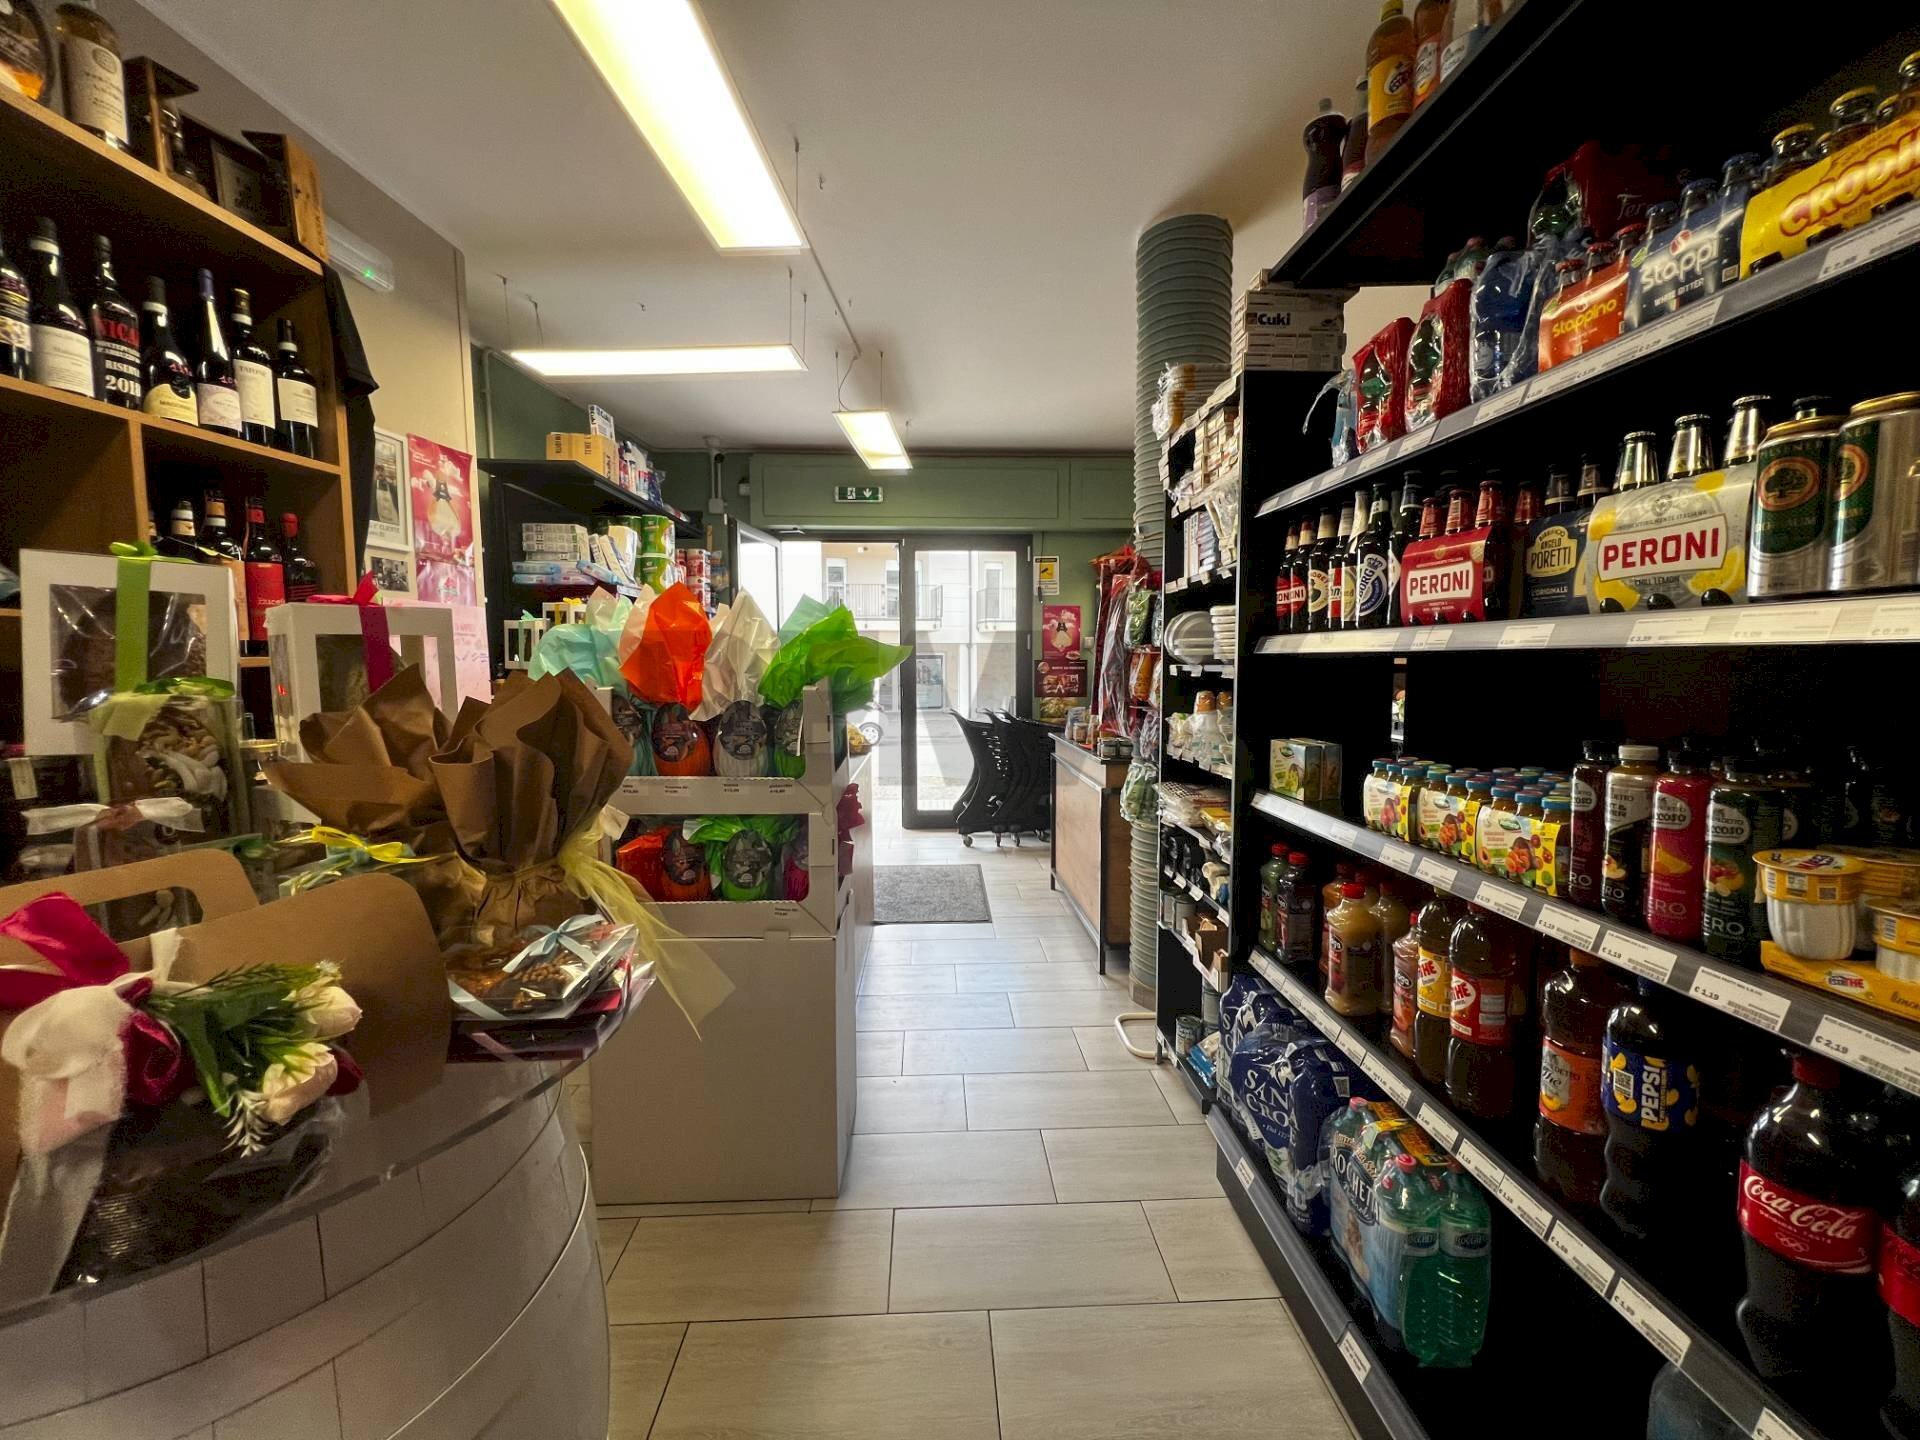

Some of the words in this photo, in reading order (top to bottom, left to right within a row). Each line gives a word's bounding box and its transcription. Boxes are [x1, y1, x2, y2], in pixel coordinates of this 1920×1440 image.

[1258, 312, 1291, 326] Cuki
[1530, 546, 1571, 570] PORETTI
[1603, 527, 1719, 571] PERONI
[1410, 569, 1470, 597] PERONI
[1701, 988, 1720, 1001] 1.19
[1824, 1038, 1849, 1055] 2.19
[1641, 1064, 1662, 1122] PEPSI
[1743, 1175, 1866, 1240] Coca-Cola
